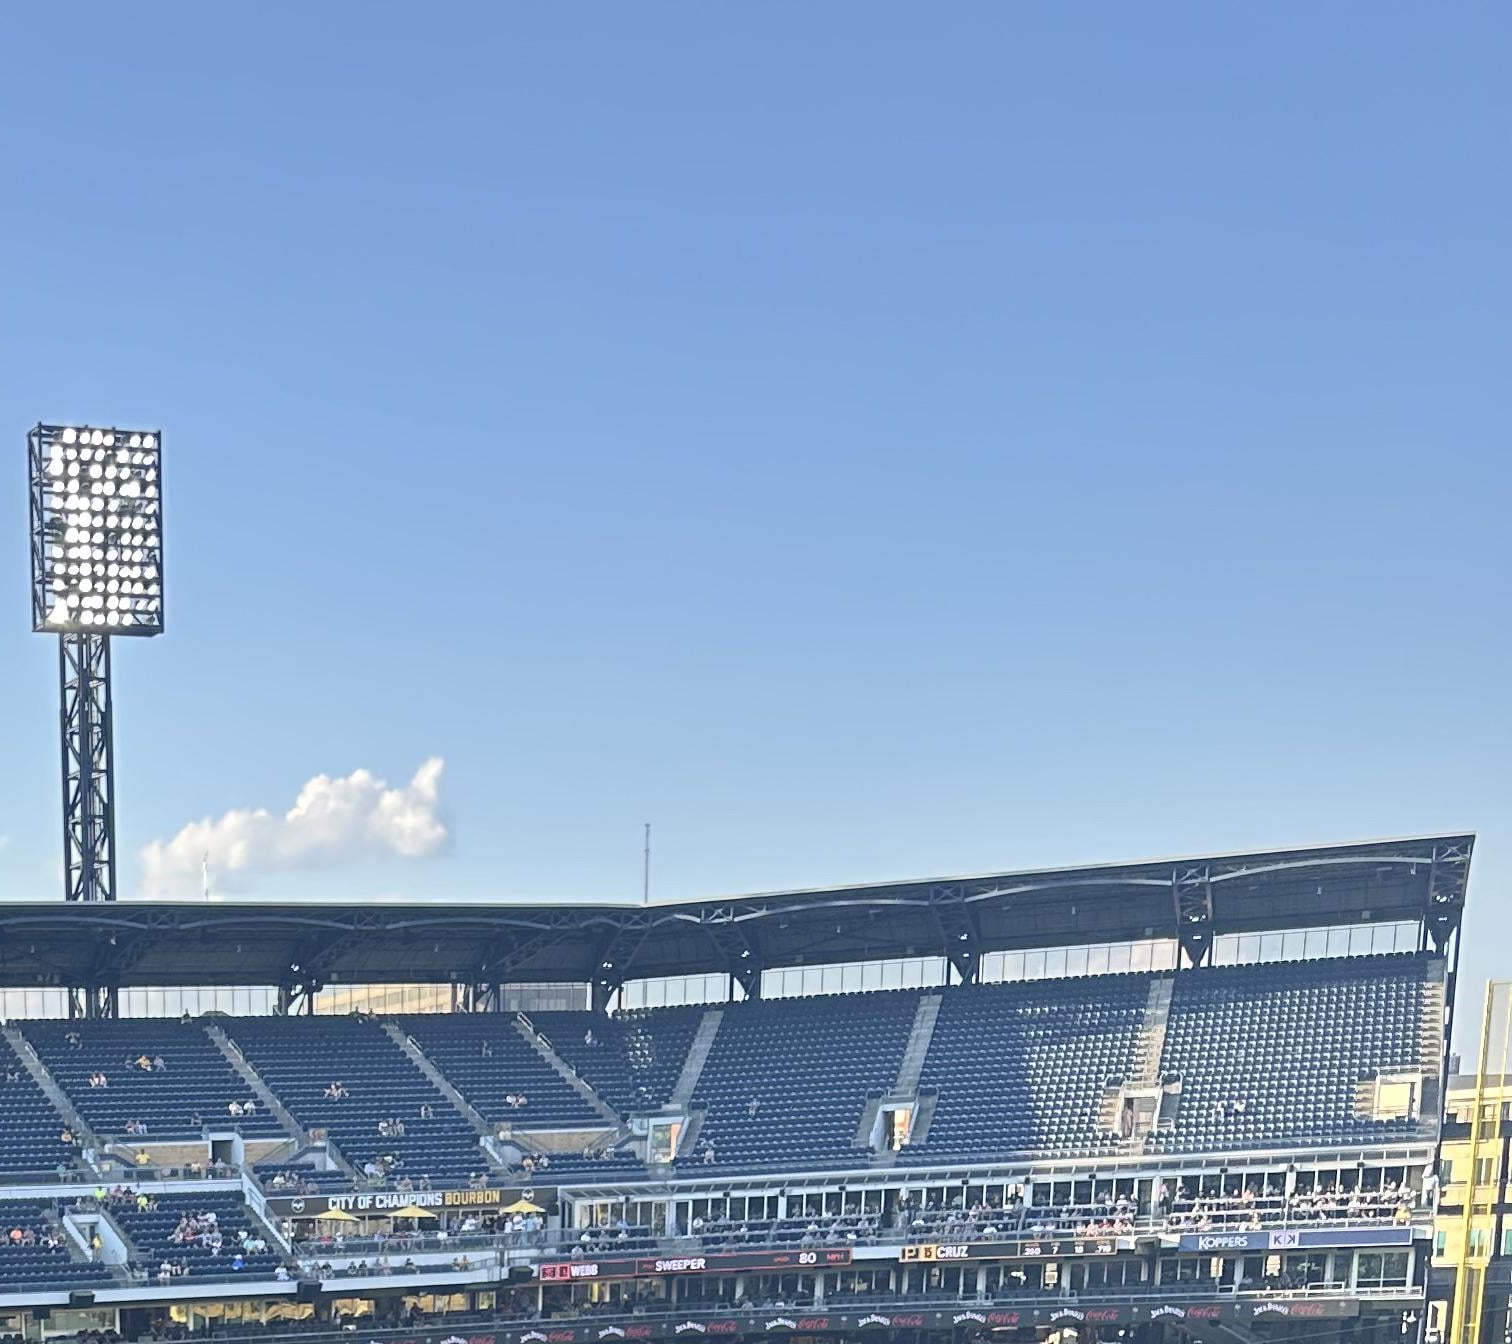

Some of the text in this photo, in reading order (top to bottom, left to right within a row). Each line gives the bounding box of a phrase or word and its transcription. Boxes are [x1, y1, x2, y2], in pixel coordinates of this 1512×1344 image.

[328, 1190, 501, 1210] CITY OF CHAMPIONS BOURBON
[1198, 1235, 1248, 1250] KOPPERS
[799, 1251, 817, 1264] 80
[937, 1245, 968, 1258] CRUZ
[571, 1264, 598, 1277] WEBB
[655, 1258, 706, 1272] SWEEPER
